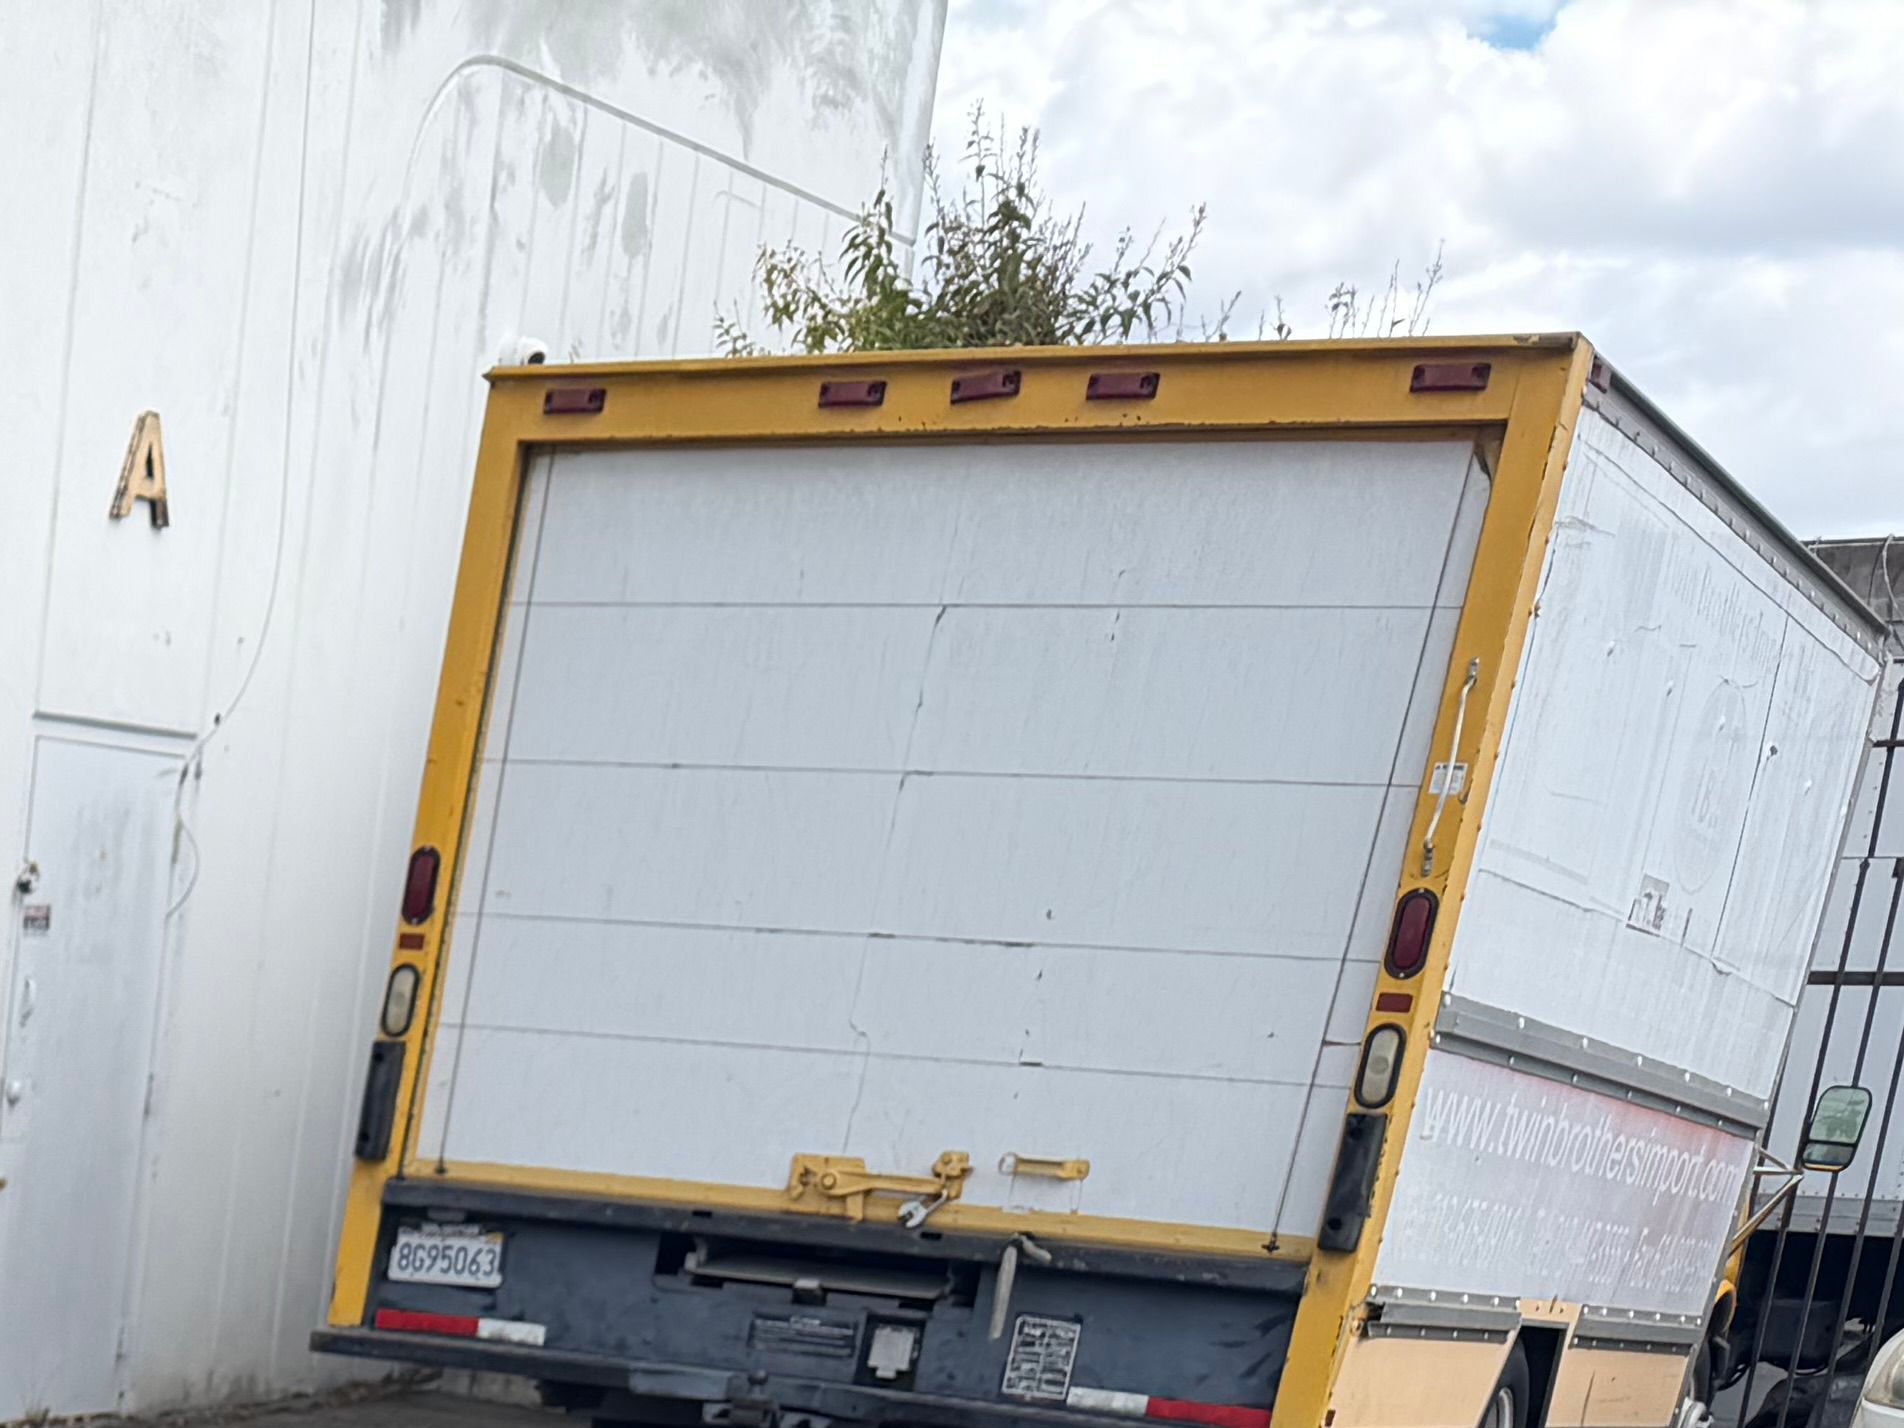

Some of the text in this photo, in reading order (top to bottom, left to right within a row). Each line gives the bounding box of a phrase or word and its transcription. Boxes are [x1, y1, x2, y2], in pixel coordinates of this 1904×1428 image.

[109, 410, 169, 531] A
[1421, 1087, 1741, 1205] www.twinbrothersimport.com
[397, 1241, 496, 1277] 8G95063
